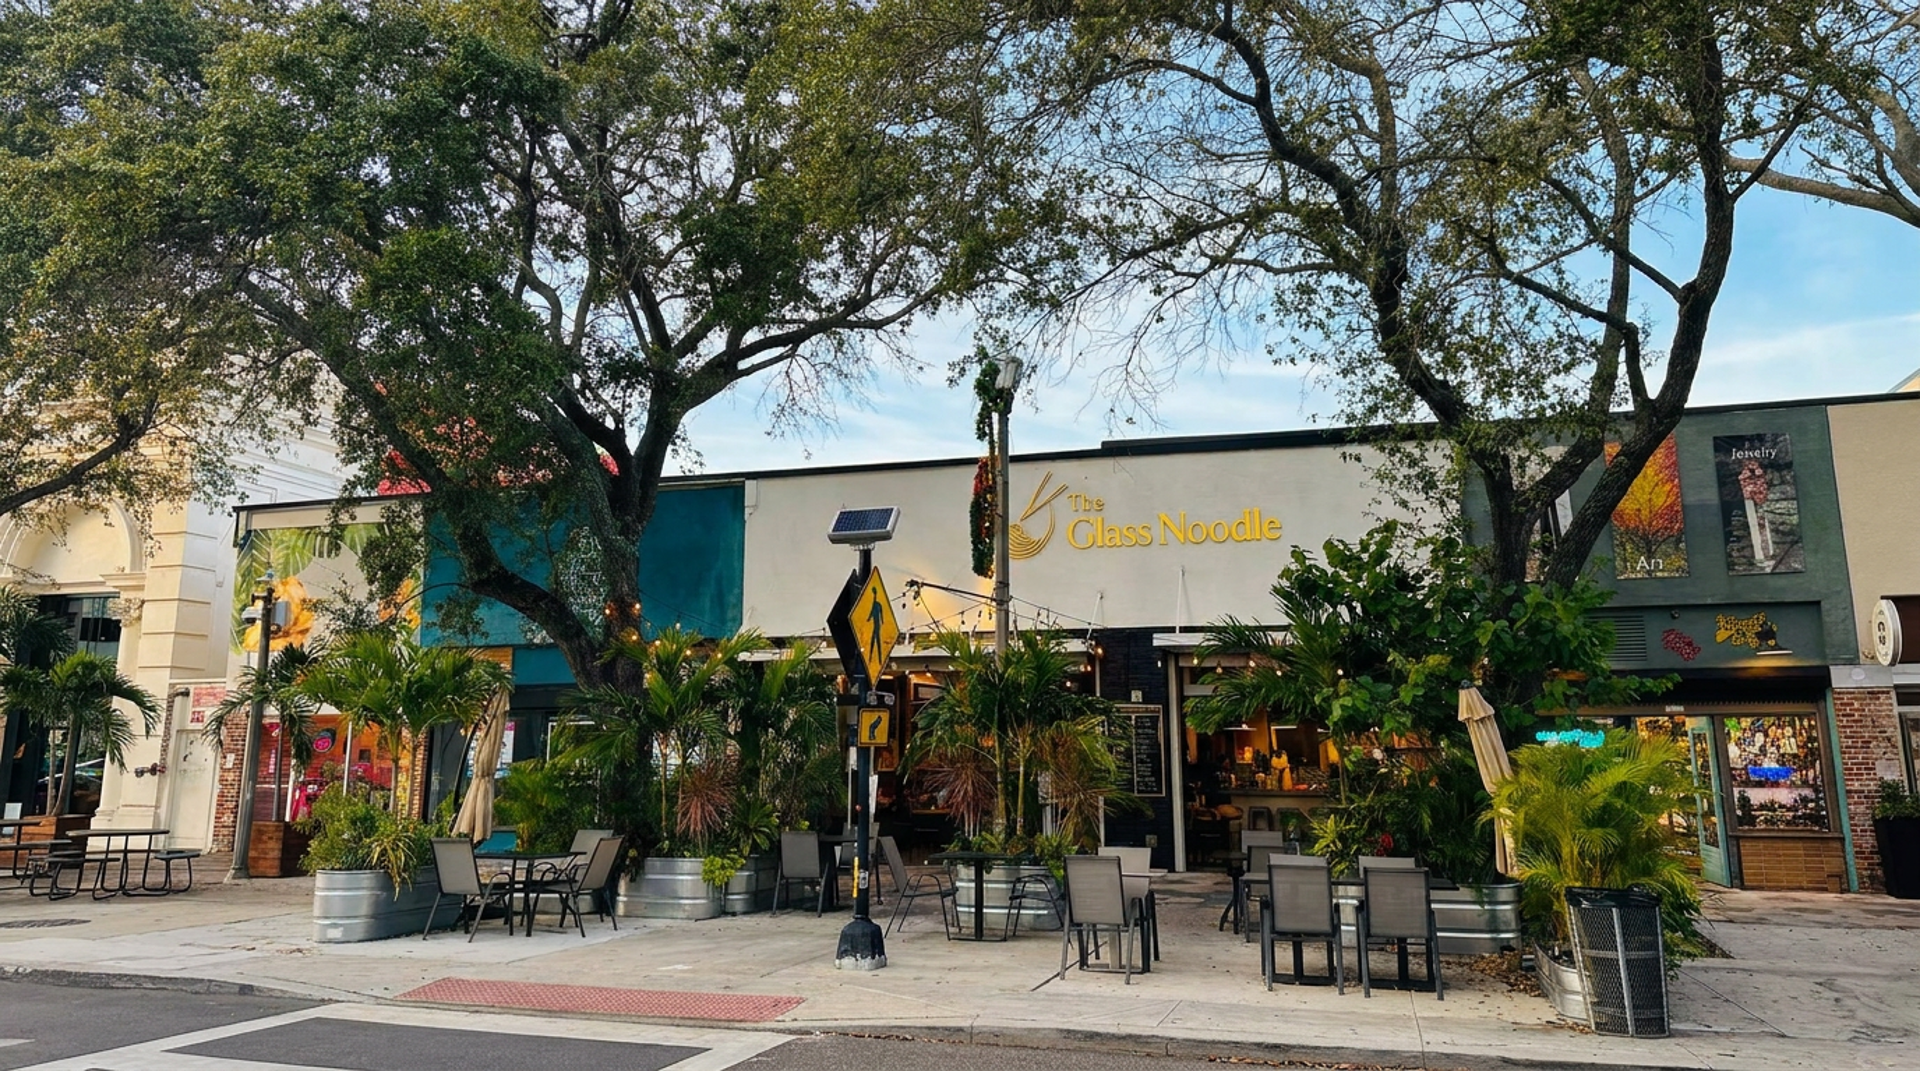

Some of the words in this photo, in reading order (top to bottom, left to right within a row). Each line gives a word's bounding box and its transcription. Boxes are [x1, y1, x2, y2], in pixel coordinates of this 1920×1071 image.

[1067, 493, 1104, 511] The
[1066, 516, 1153, 549] Glass
[1158, 507, 1282, 545] Noodle
